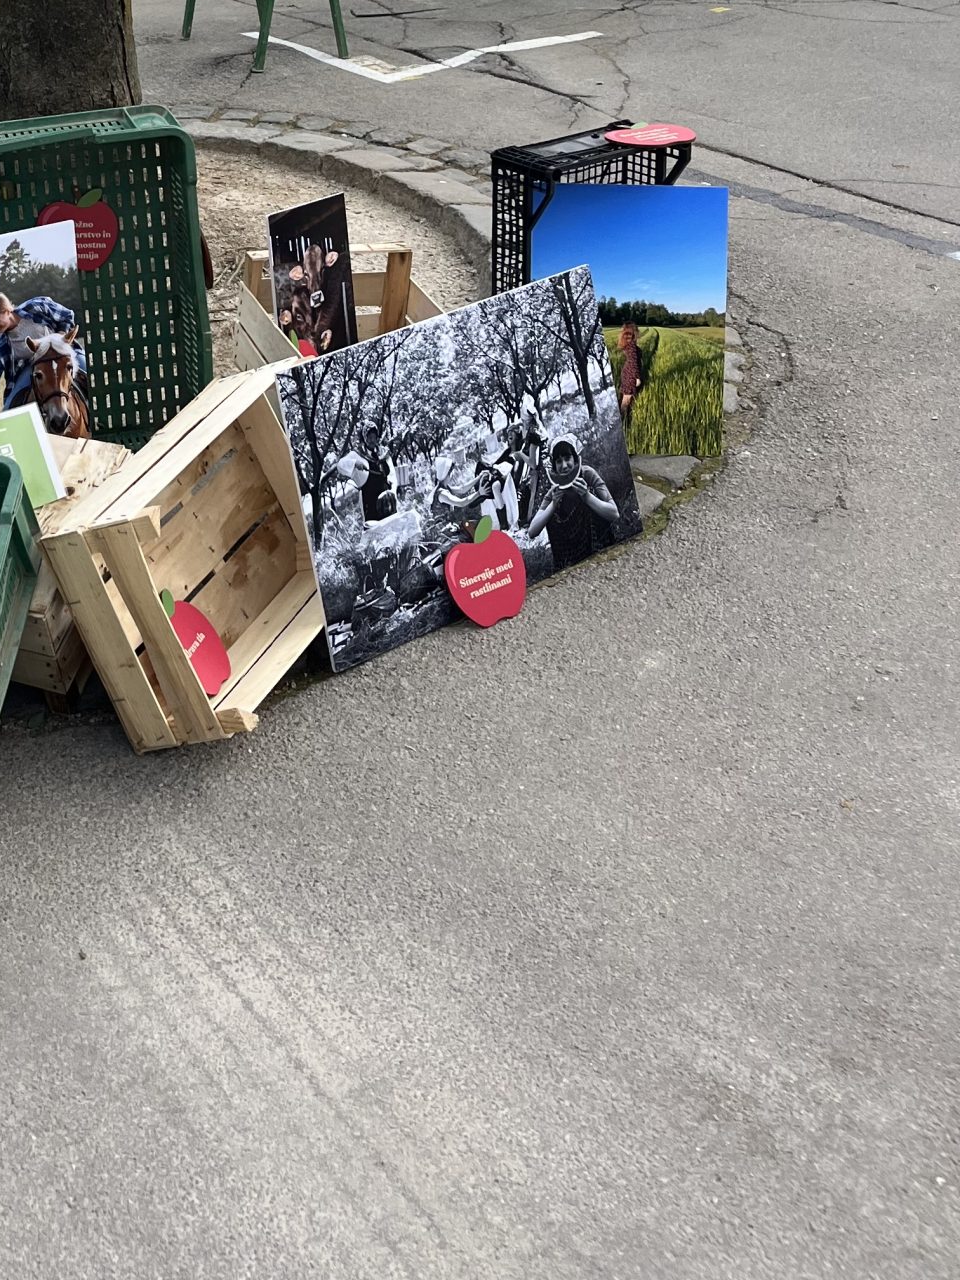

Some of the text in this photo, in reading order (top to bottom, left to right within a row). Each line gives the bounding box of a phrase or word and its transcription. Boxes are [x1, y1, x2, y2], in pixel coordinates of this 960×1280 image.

[102, 229, 111, 238] in
[459, 558, 514, 588] Sinergije med
[470, 573, 513, 599] rastlinami
[184, 639, 200, 659] drava
